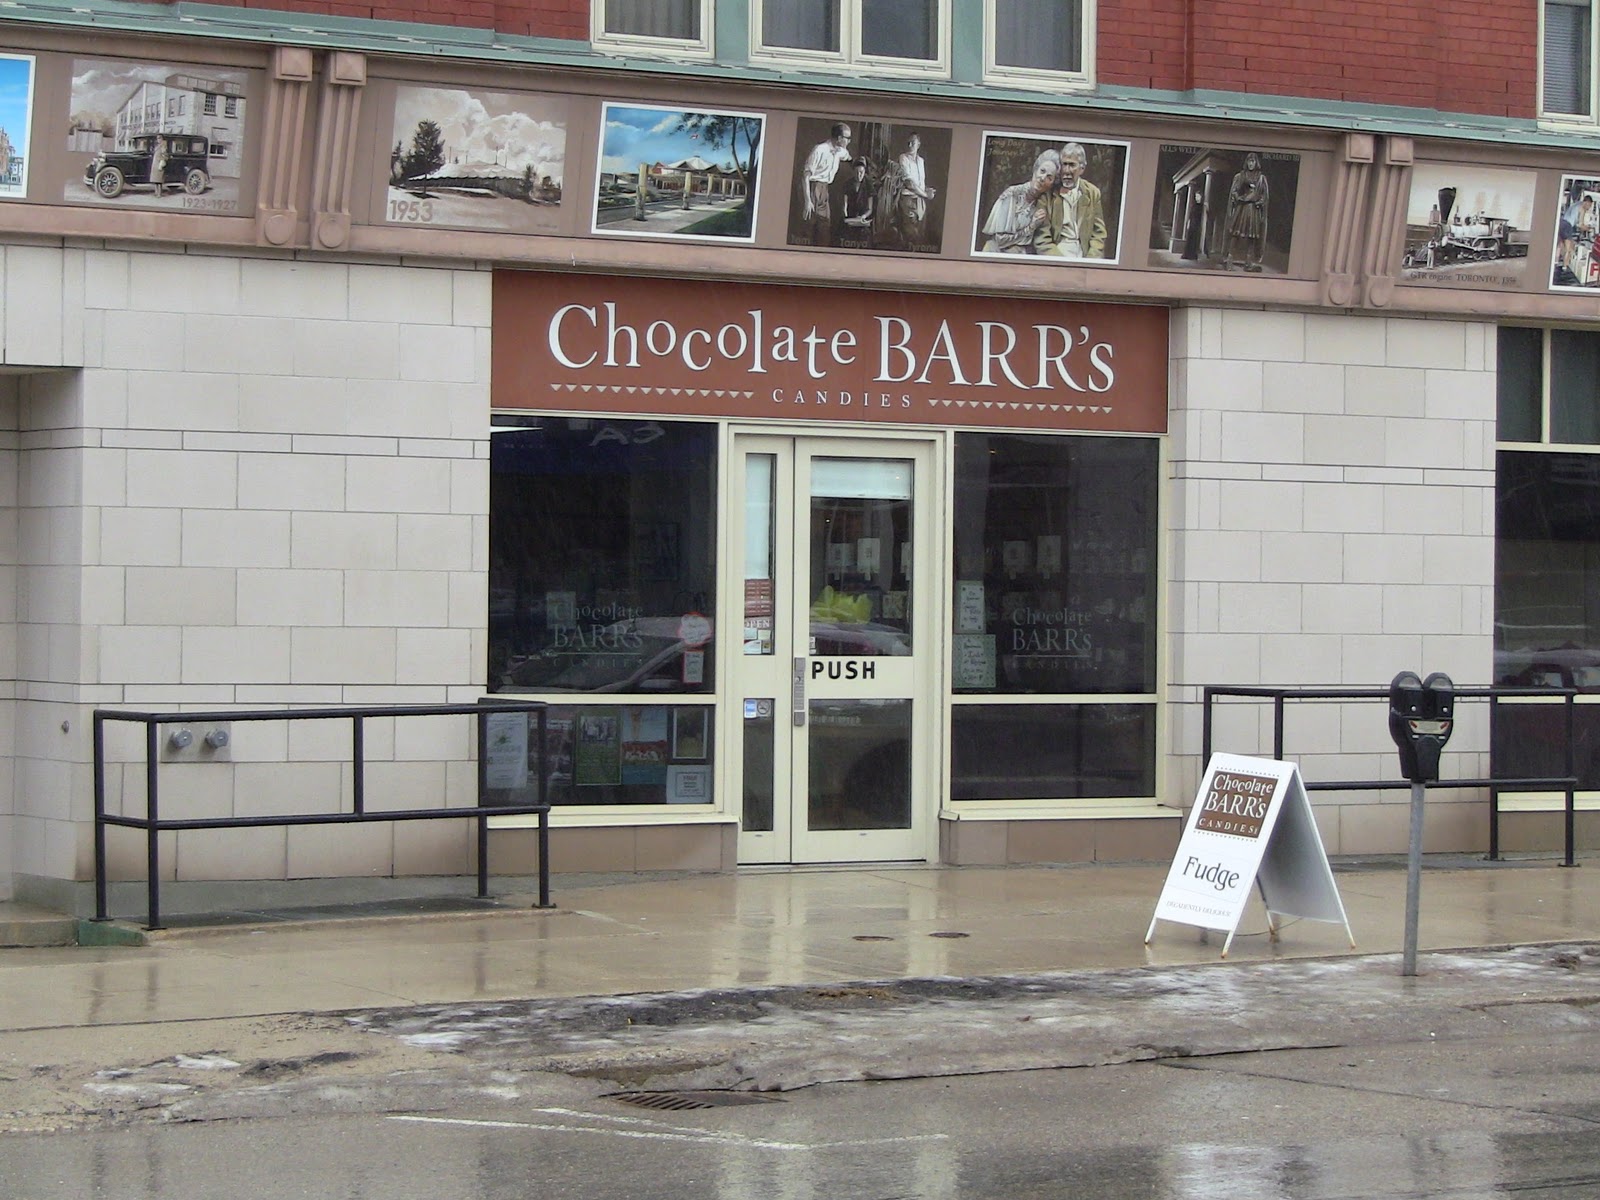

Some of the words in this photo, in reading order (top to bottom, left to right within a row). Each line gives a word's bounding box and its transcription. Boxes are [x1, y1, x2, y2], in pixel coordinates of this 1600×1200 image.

[182, 197, 237, 210] 1923-1927
[389, 200, 433, 223] 1953
[547, 301, 857, 379] Chocolate
[873, 314, 1116, 393] BARR's
[772, 388, 912, 408] CANDIES
[554, 601, 643, 621] Chocolate
[1012, 607, 1092, 626] Chocolate
[812, 660, 876, 680] PUSH
[1213, 774, 1273, 796] Chocolate
[1204, 790, 1267, 818] BARR's
[1182, 855, 1240, 891] Fudge
